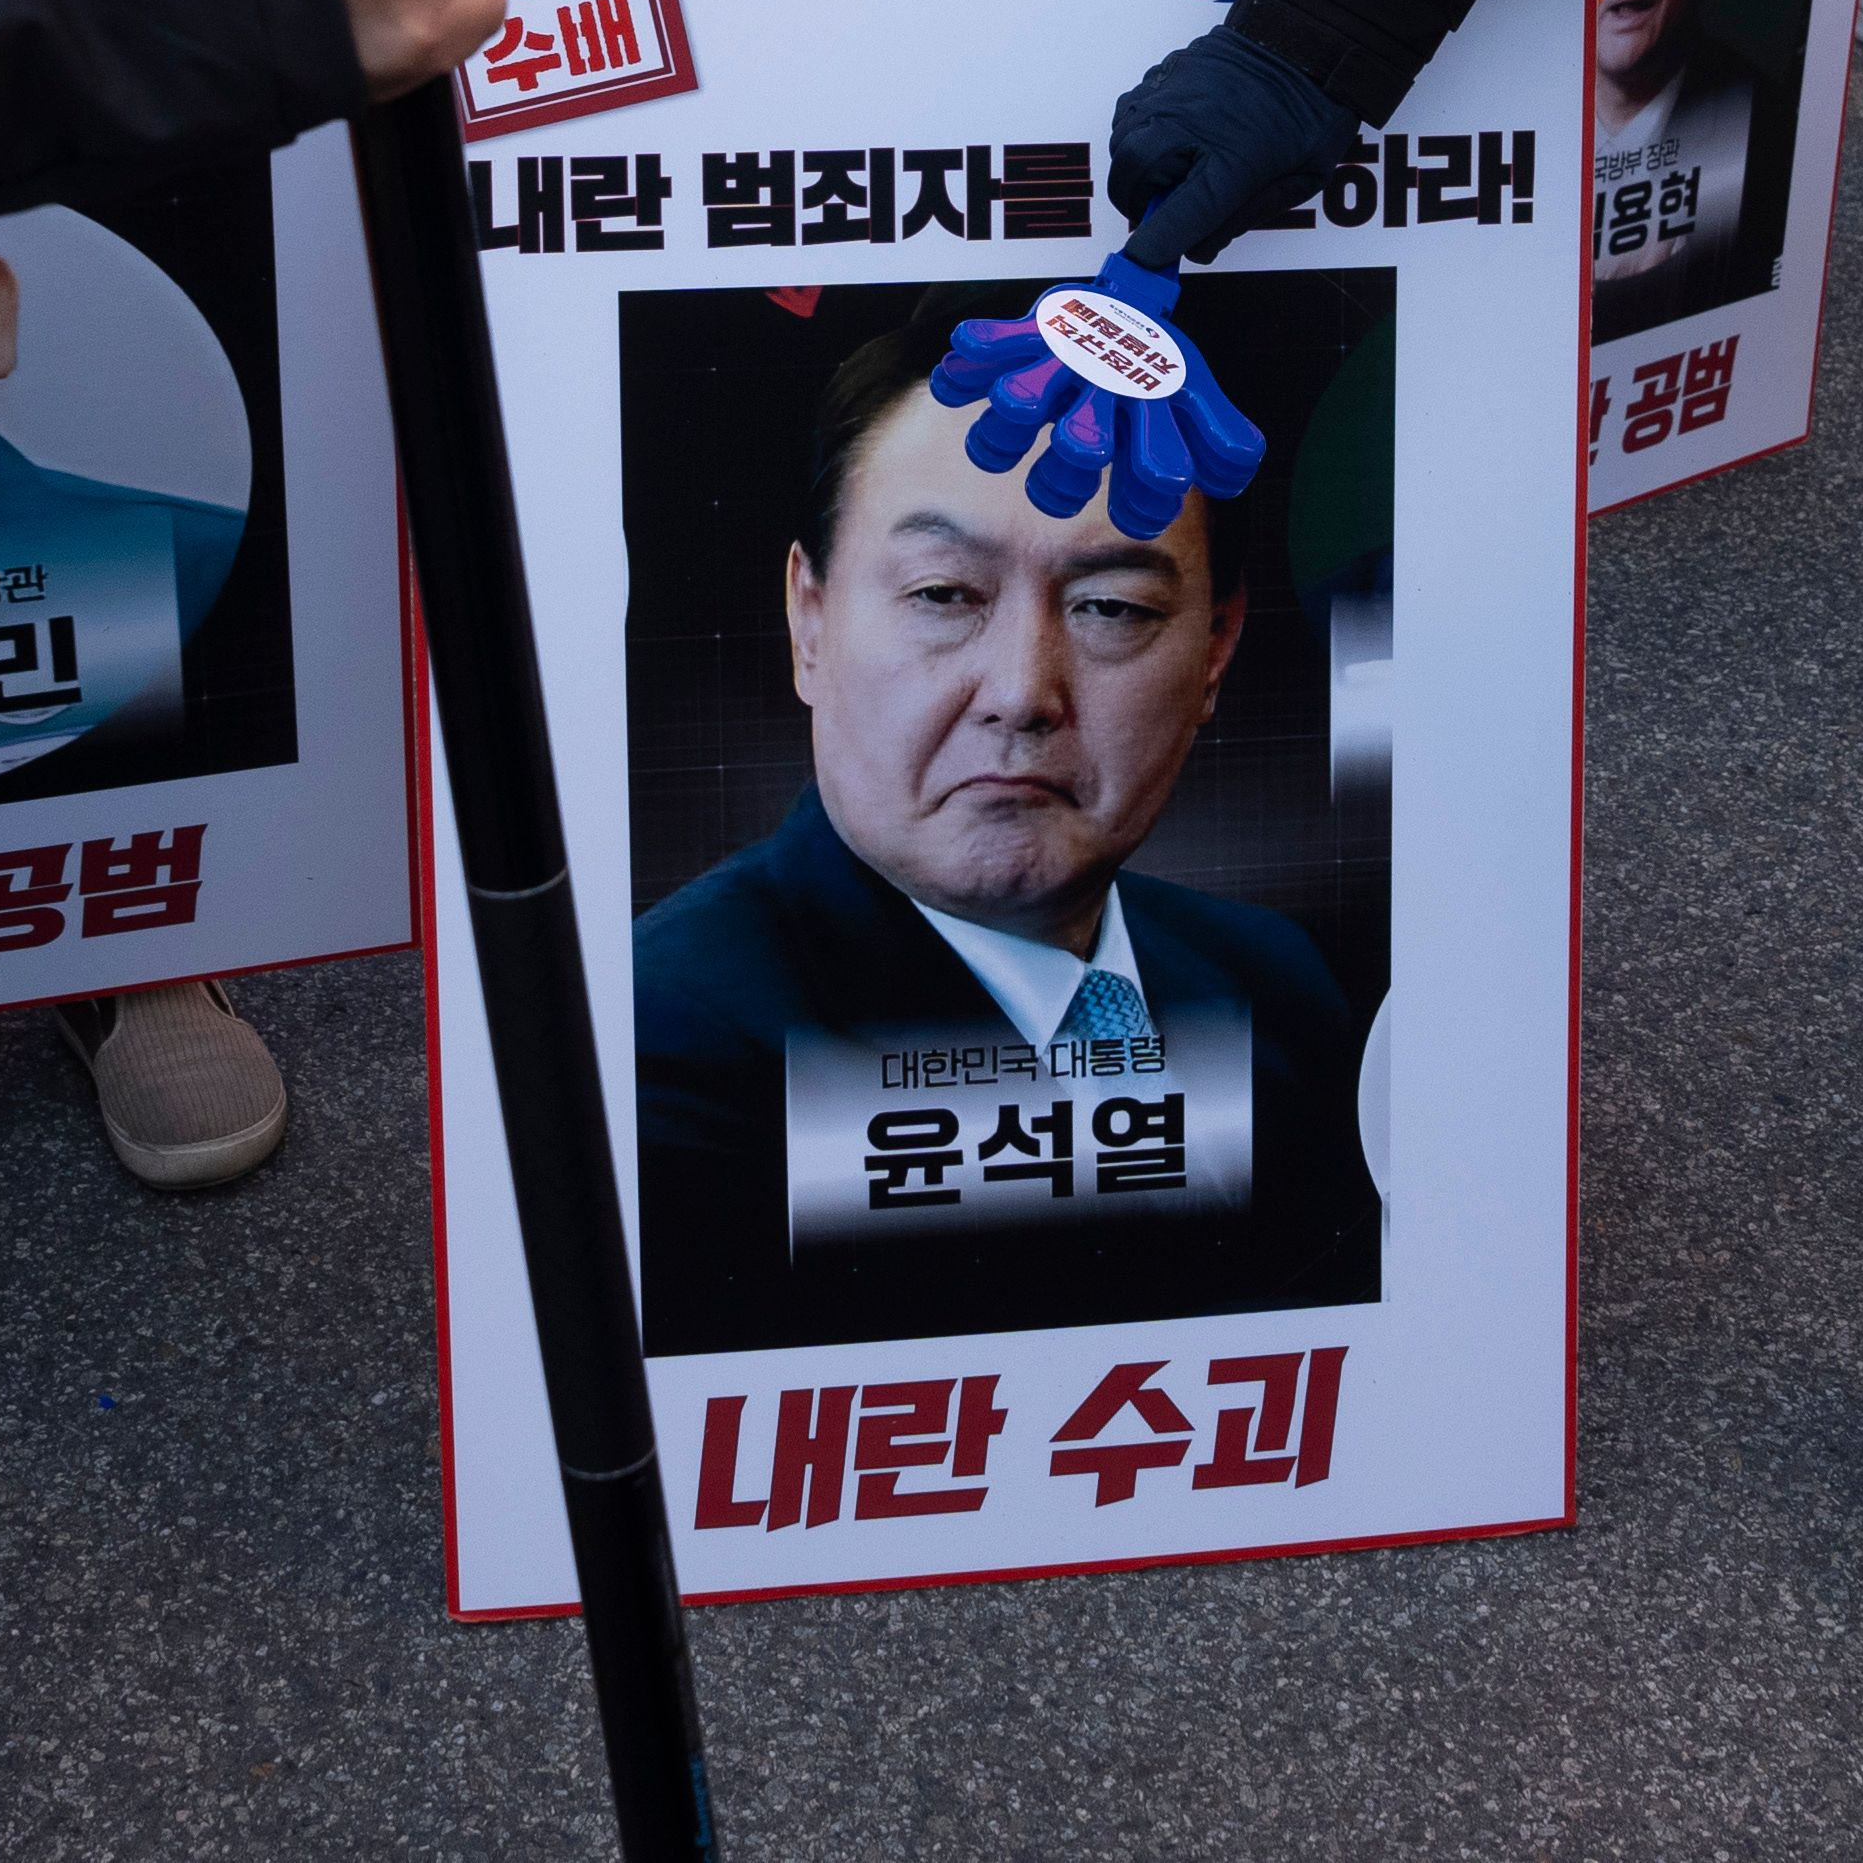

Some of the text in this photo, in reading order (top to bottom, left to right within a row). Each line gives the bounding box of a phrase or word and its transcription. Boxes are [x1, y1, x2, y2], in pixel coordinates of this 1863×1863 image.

[466, 152, 673, 254] 내란
[701, 141, 1095, 250] 범죄자를
[1646, 137, 1681, 172] 장관
[1044, 314, 1161, 392] 비정규직
[1060, 298, 1179, 376] 차별철폐
[1621, 333, 1741, 455] 공범
[881, 1033, 1169, 1092] 대한민국 대통령
[862, 1092, 1188, 1211] 윤석열
[693, 1345, 1351, 1534] 내란 수괴
